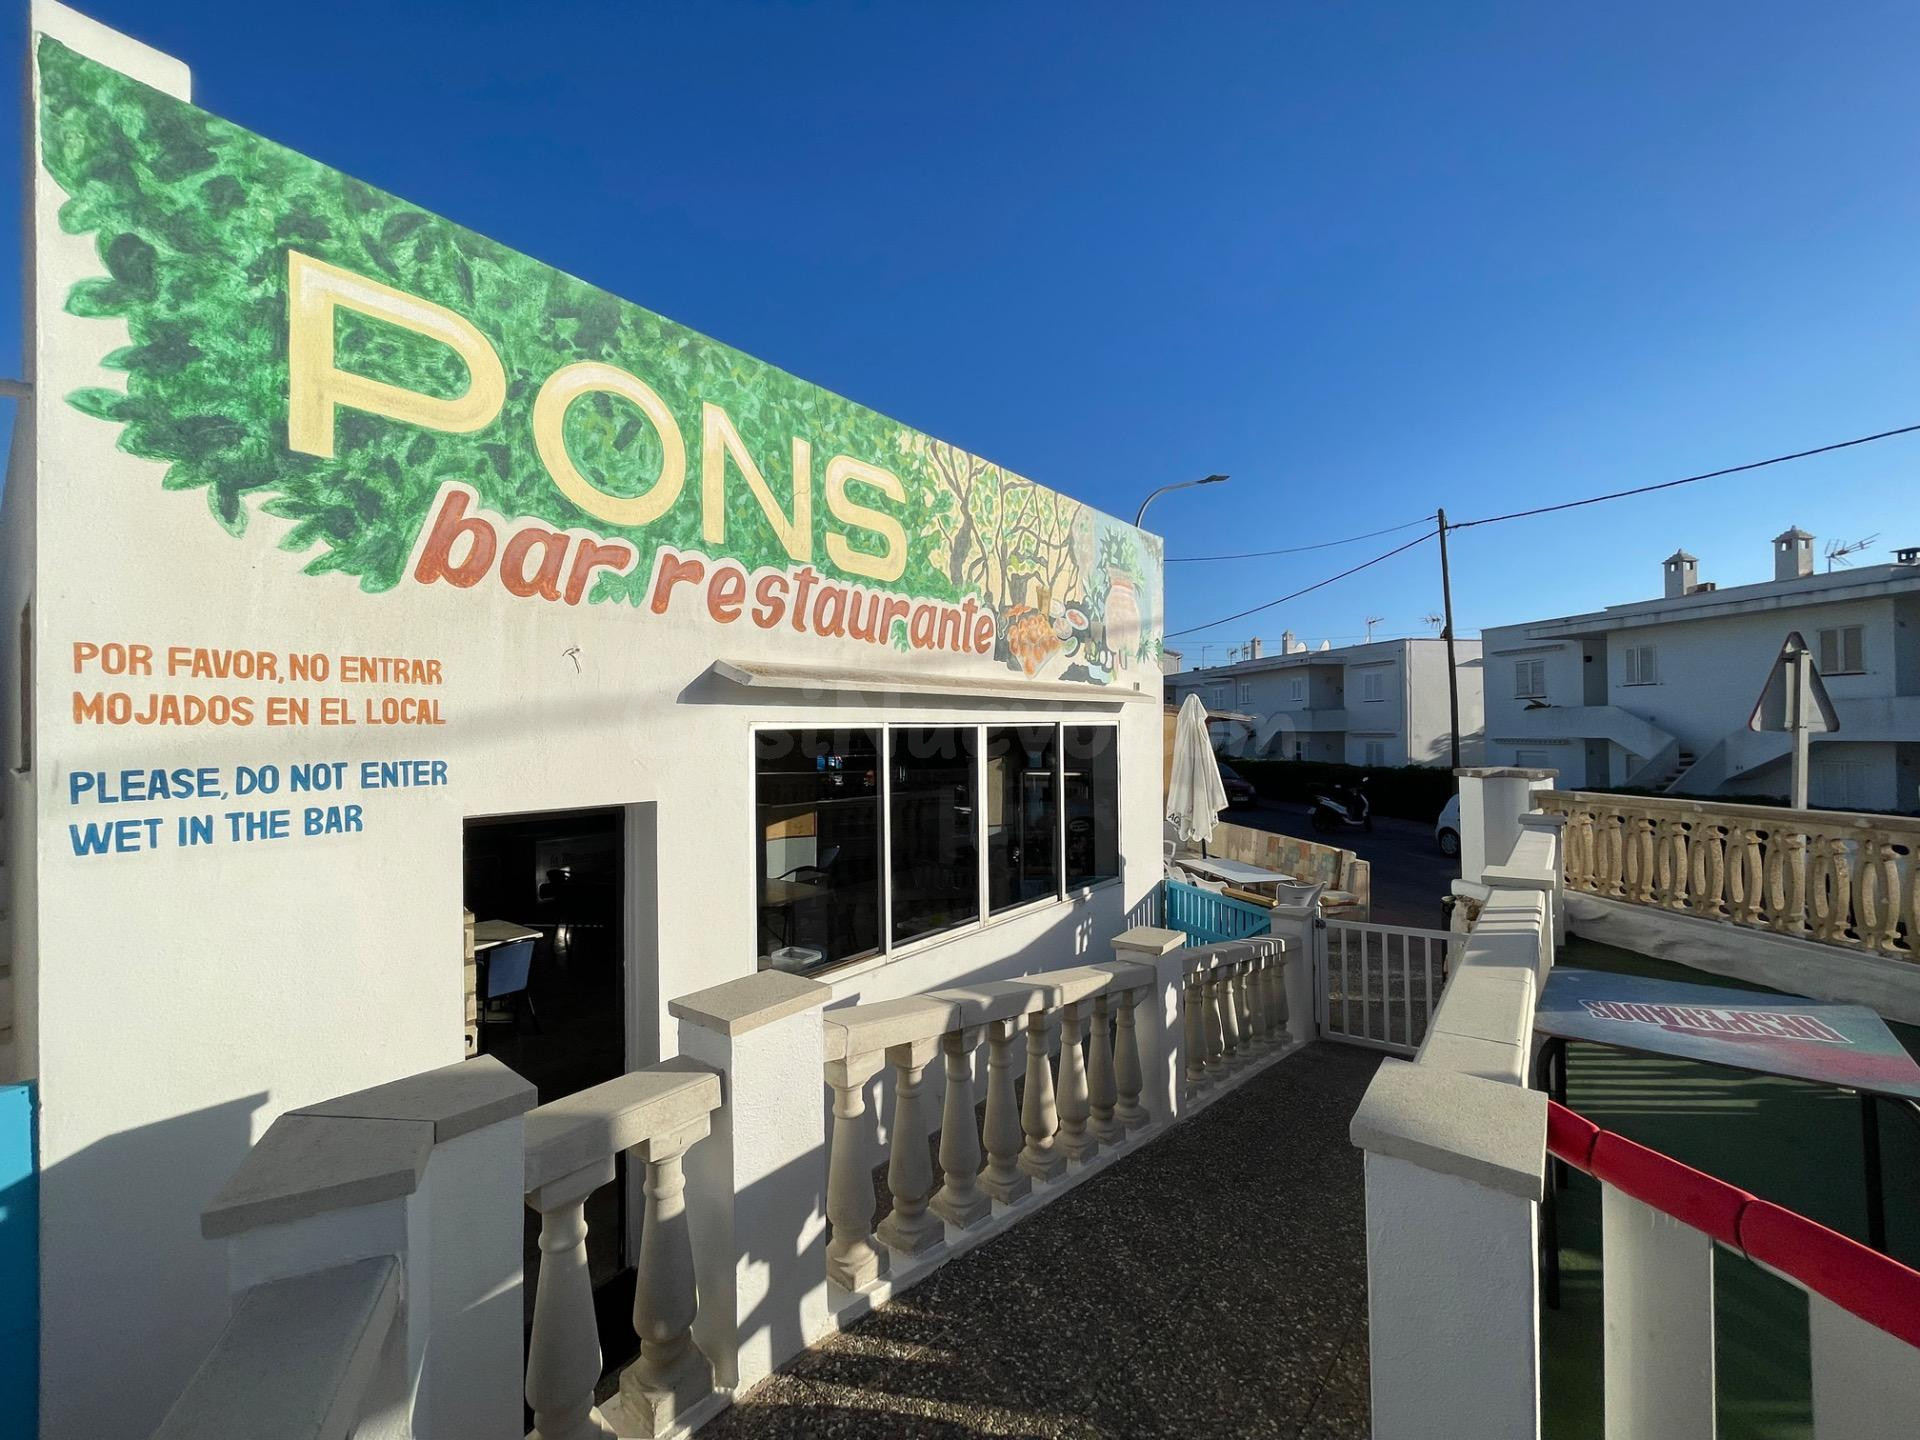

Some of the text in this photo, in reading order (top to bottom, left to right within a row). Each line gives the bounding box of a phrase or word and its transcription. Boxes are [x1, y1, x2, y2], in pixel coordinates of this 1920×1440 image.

[287, 249, 908, 582] PONS
[414, 489, 996, 655] bar restaurante
[73, 641, 443, 685] POR FAVOR, NO ENTRAR
[72, 691, 446, 727] MOJADOS EN EL LOCAL
[69, 760, 449, 805] PLEASE, DO NOT ENTER
[68, 804, 364, 857] WET IN THE BAR
[1578, 1000, 1855, 1043] DESPERADOS
